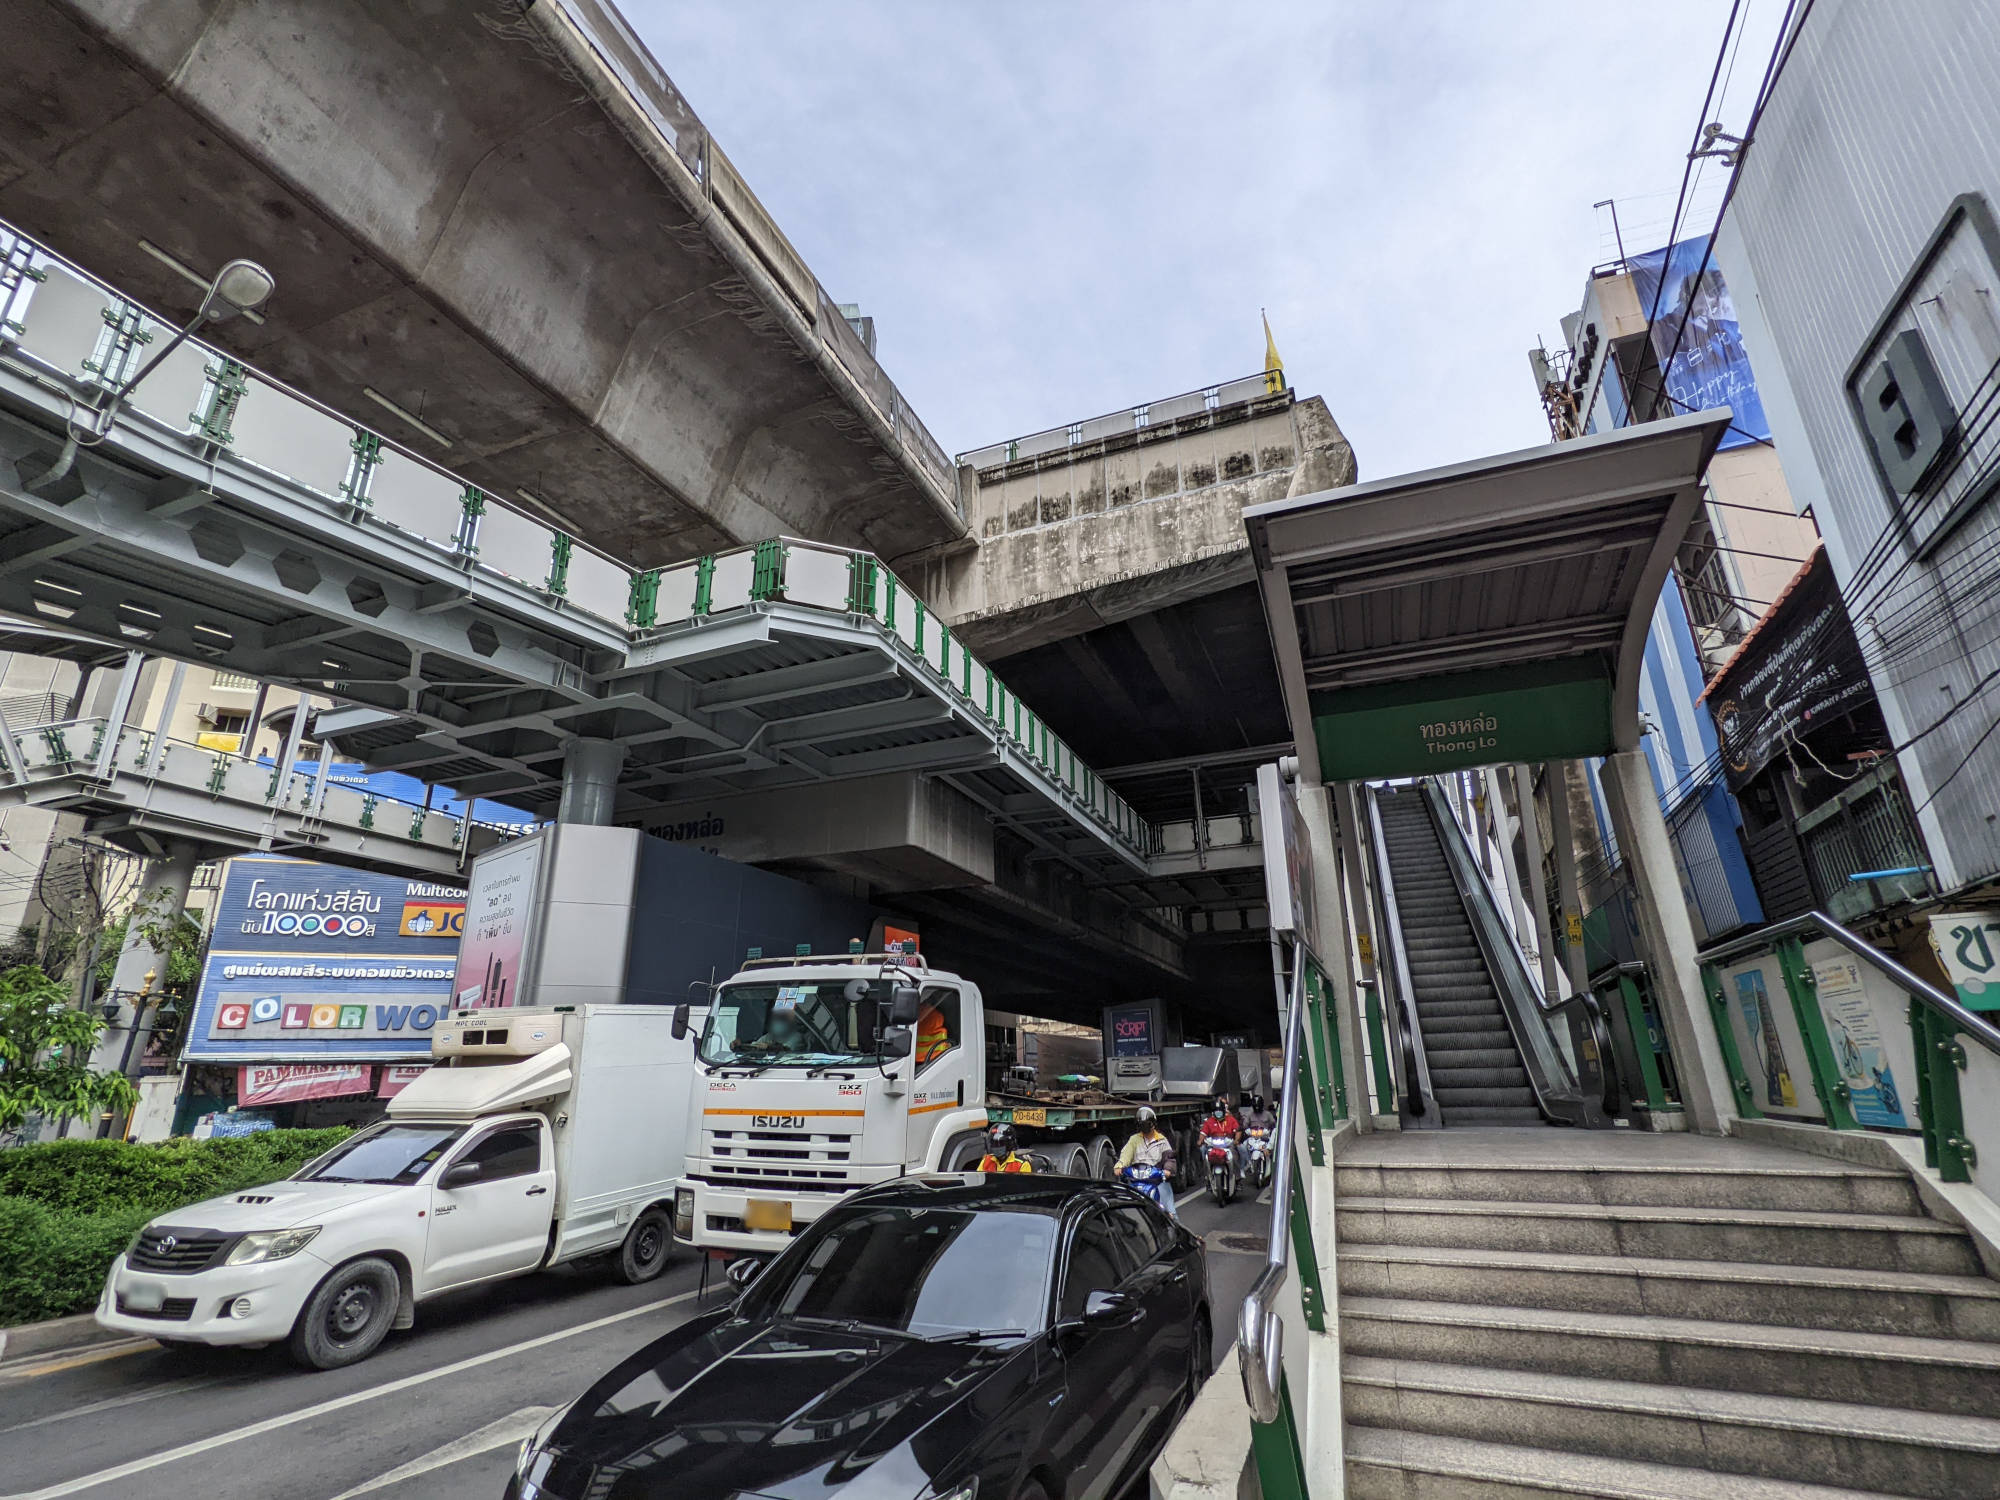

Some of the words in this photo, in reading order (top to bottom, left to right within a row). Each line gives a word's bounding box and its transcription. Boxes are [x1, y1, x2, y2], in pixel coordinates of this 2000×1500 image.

[1420, 712, 1498, 739] ทองหล่อ
[1426, 741, 1476, 754] Thong
[1479, 736, 1497, 748] Lo
[247, 879, 382, 913] โลกแห่งสีสัน
[220, 997, 363, 1028] COLOR
[1115, 1021, 1147, 1037] SCRIPT
[752, 1115, 805, 1129] ISUZU
[1015, 1111, 1044, 1122] 70-6439
